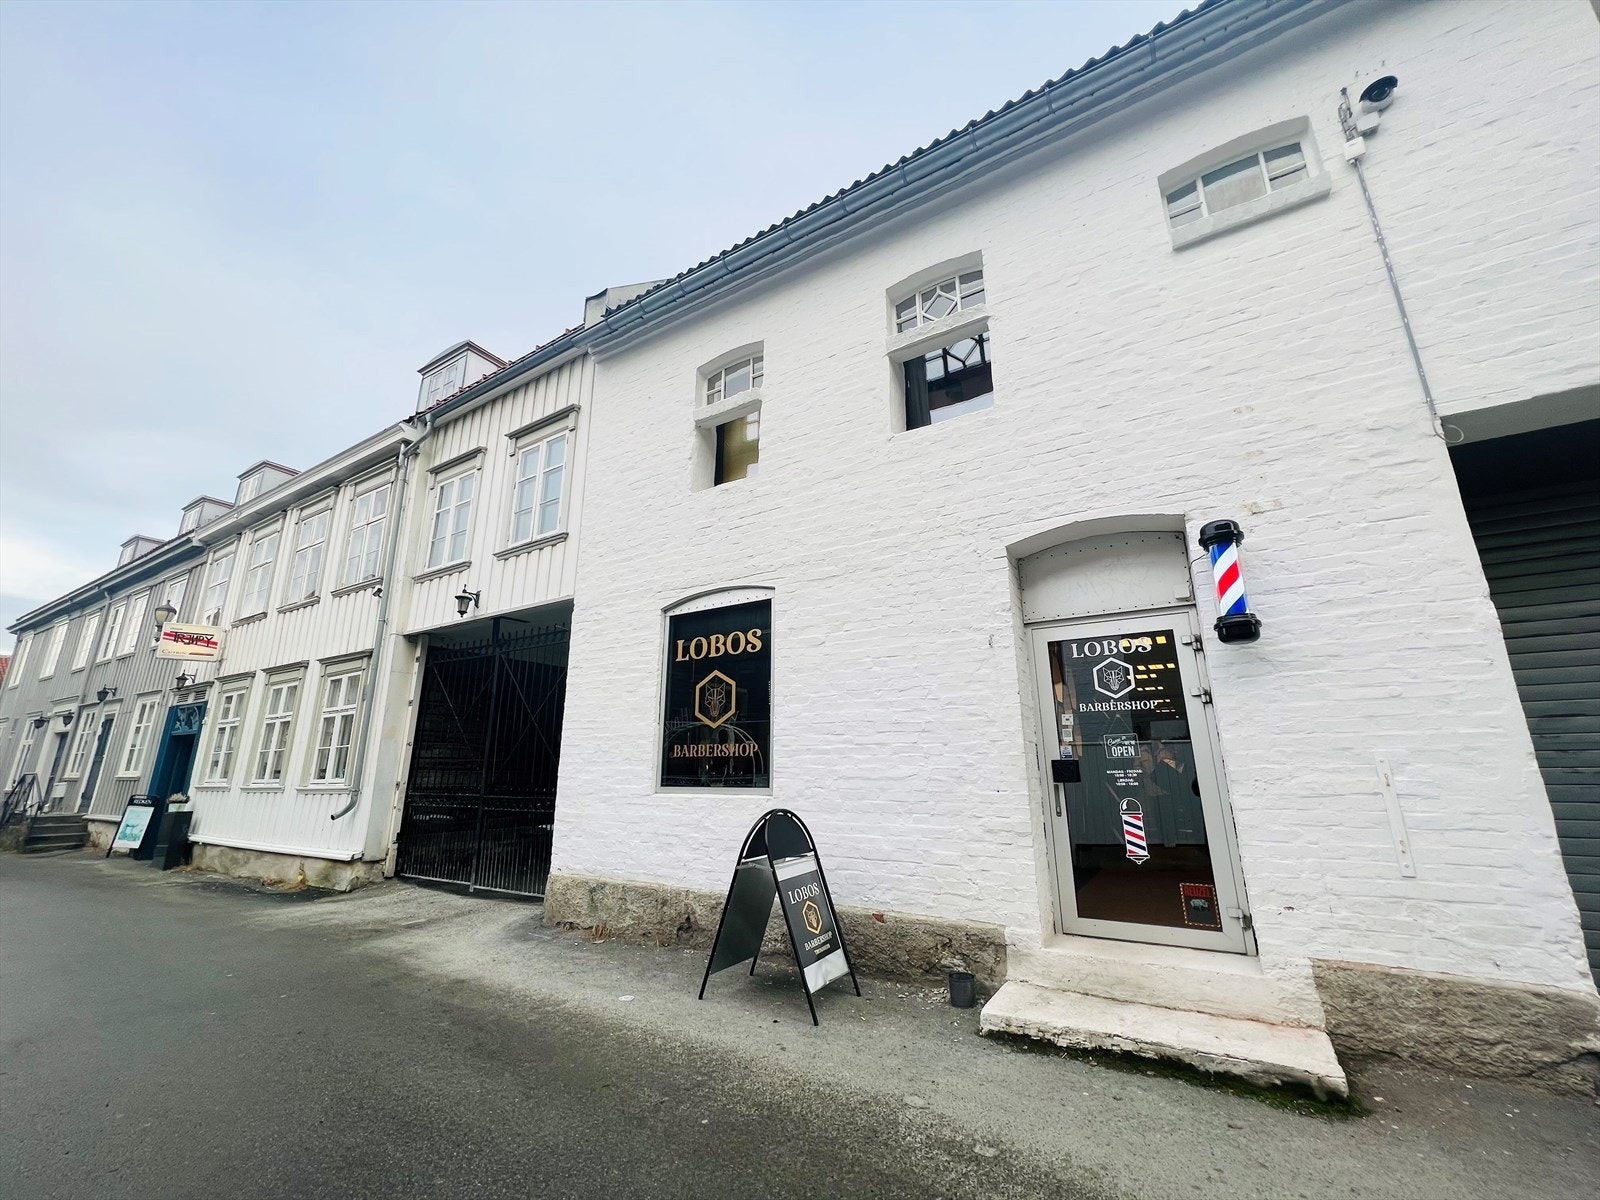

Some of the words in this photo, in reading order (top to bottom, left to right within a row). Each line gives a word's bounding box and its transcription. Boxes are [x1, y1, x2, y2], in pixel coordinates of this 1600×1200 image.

[675, 628, 763, 662] LOBOS
[1070, 636, 1152, 659] LOBOS
[1079, 700, 1158, 713] BARBERSHOP
[673, 742, 758, 758] BARBERSHOP
[1111, 745, 1135, 757] OPEN
[788, 882, 820, 905] LOBOS
[804, 930, 833, 951] BARBERSHOP
